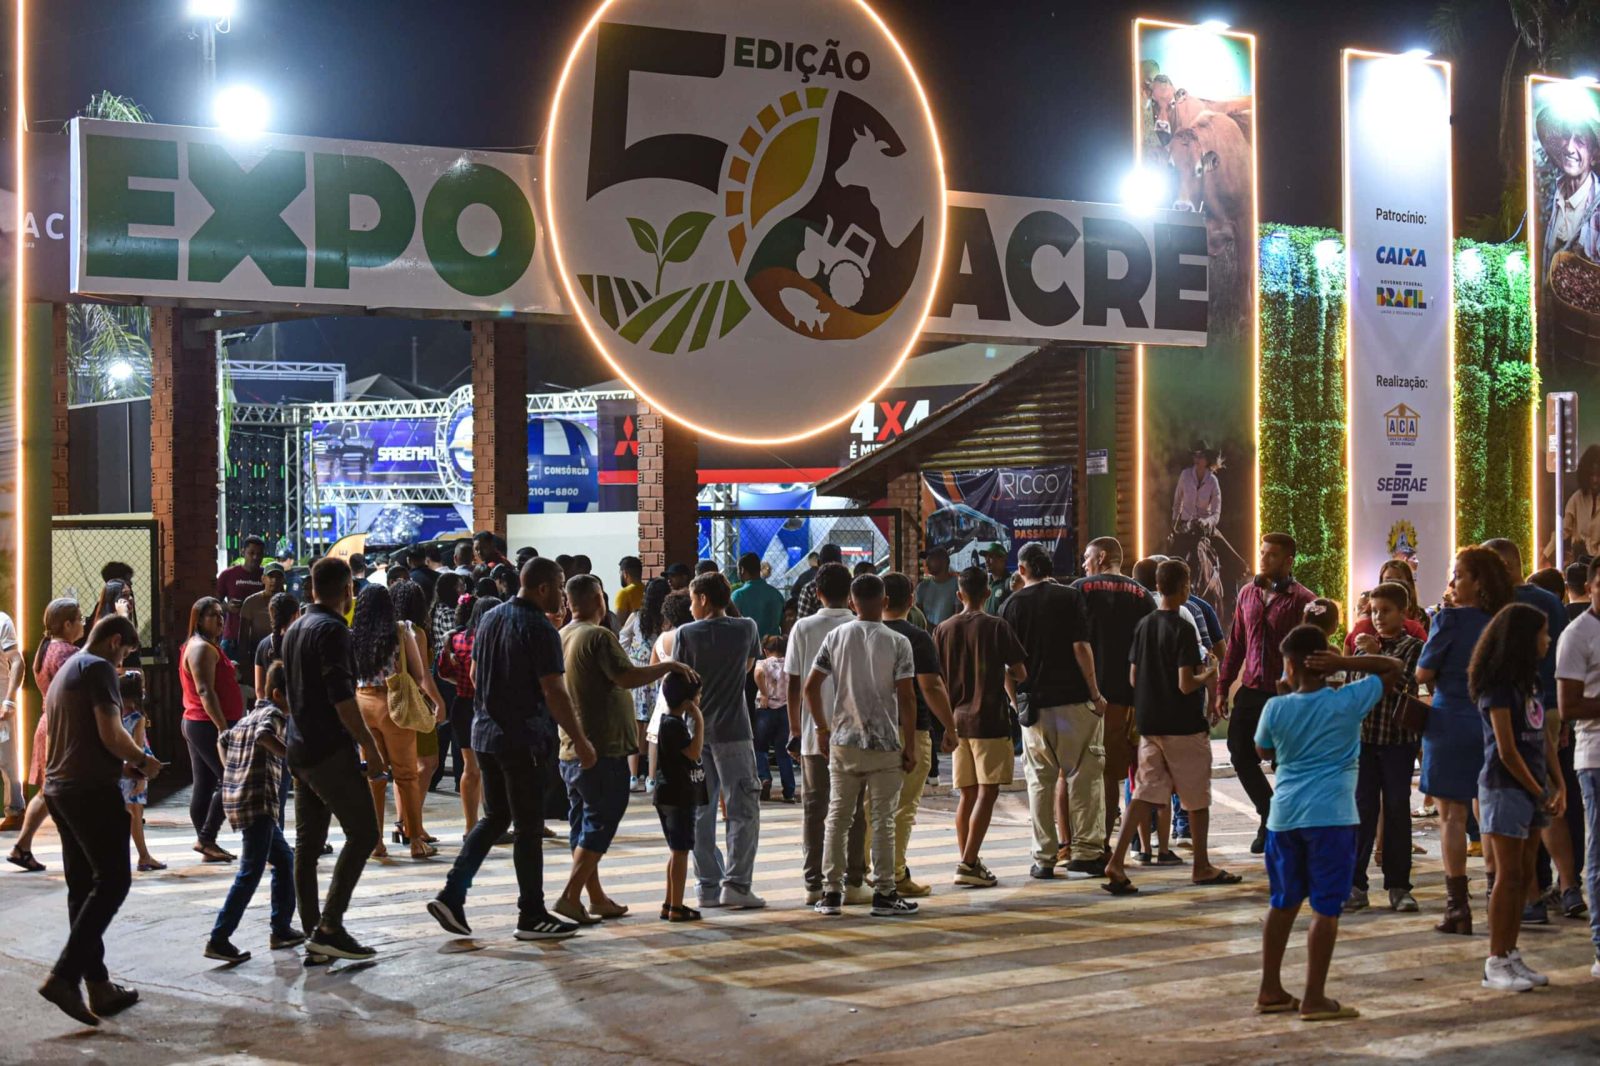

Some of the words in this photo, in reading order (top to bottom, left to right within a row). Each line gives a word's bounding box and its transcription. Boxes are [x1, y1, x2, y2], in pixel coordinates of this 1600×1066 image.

[733, 36, 871, 83] EDIÇÃO
[86, 133, 537, 297] EXPO
[1376, 207, 1427, 225] Patrocínio:
[1375, 245, 1427, 267] CAIXA
[928, 205, 1208, 333] ACRE
[1376, 286, 1427, 309] BRASIL
[1376, 374, 1428, 391] Realização:
[849, 441, 858, 459] É
[544, 464, 590, 476] CONSÓRCIO
[528, 487, 579, 496] 2106-6800
[997, 472, 1060, 500] RICCO
[1376, 477, 1428, 492] SEBRAE
[1013, 518, 1043, 527] COMPRE
[1044, 515, 1067, 527] SUA
[1014, 528, 1067, 539] PASSAGEM
